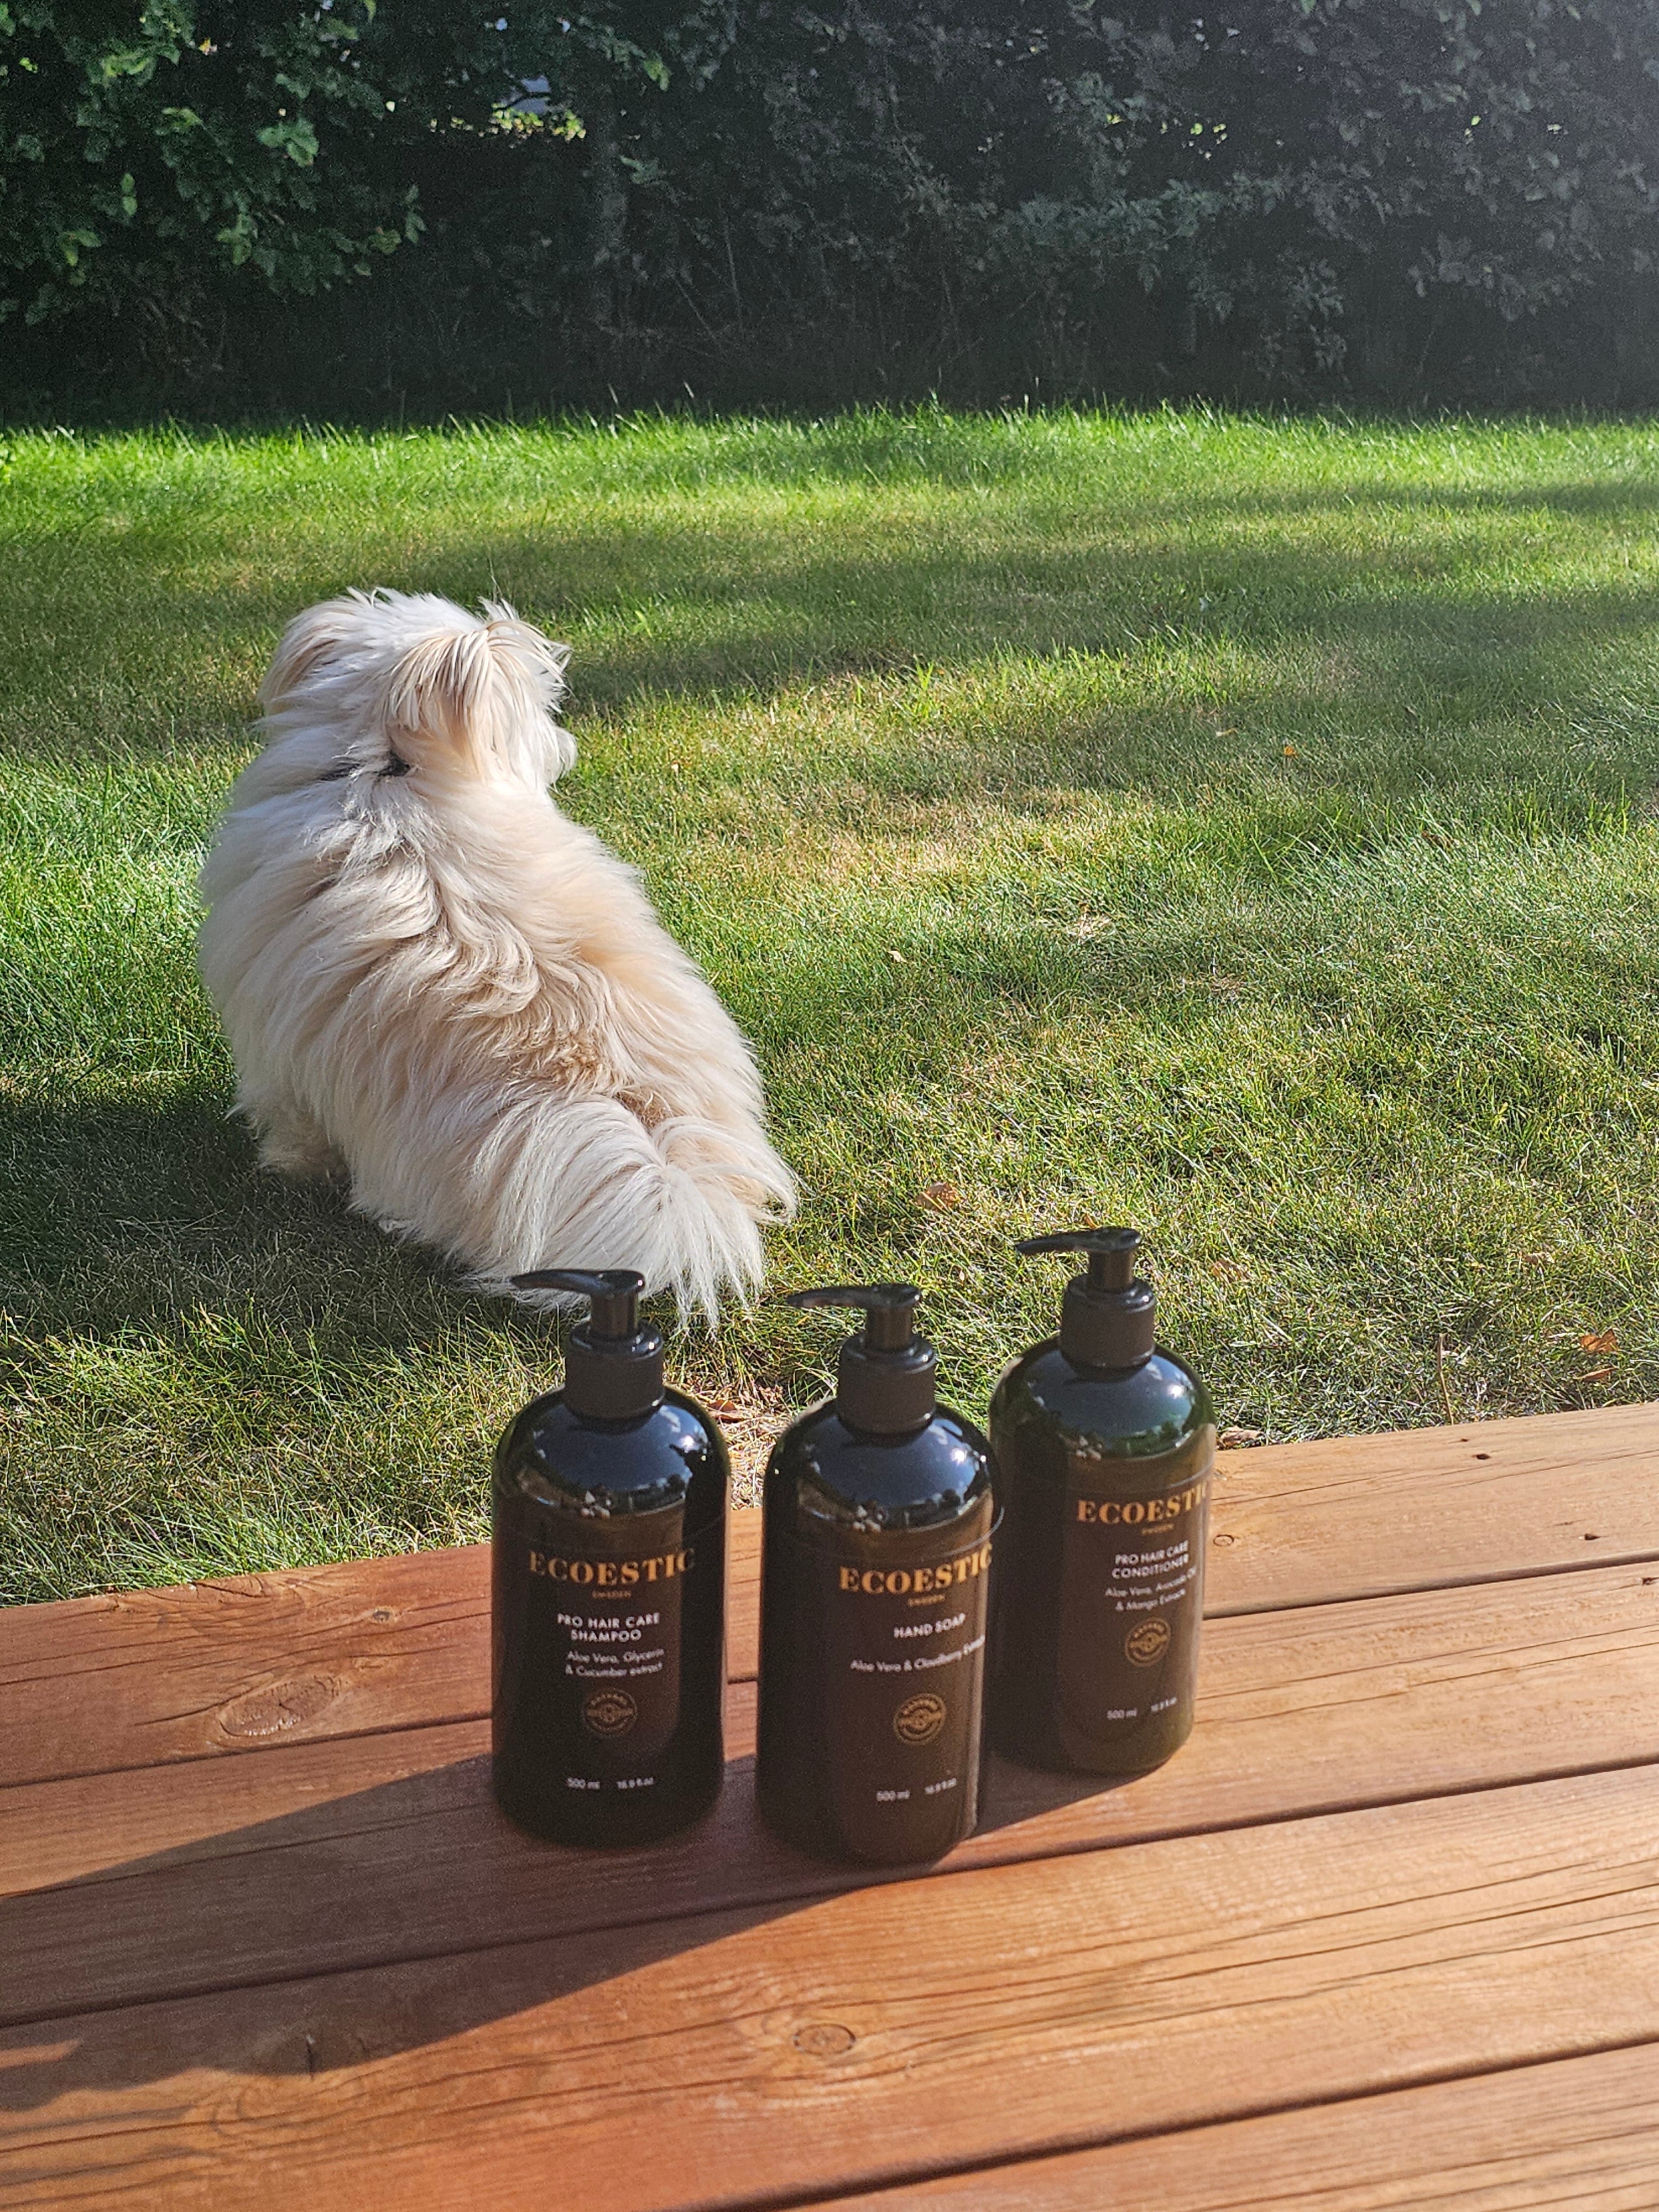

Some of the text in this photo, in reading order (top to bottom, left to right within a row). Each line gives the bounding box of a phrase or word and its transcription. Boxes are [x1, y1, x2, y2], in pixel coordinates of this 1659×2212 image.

[1115, 1540, 1189, 1566] PRO HAIR CARE
[529, 1548, 695, 1587] ECOESTIC
[1112, 1553, 1189, 1579] CONDITIONER
[1115, 1600, 1124, 1611] &
[557, 1612, 660, 1629] PRO HAIR CARE
[893, 1613, 966, 1639] HAND SOAP
[571, 1629, 641, 1643] SHAMPOO
[566, 1650, 590, 1663] Aloe
[565, 1664, 573, 1675] &
[850, 1658, 875, 1672] Aloe
[904, 1658, 912, 1671] &
